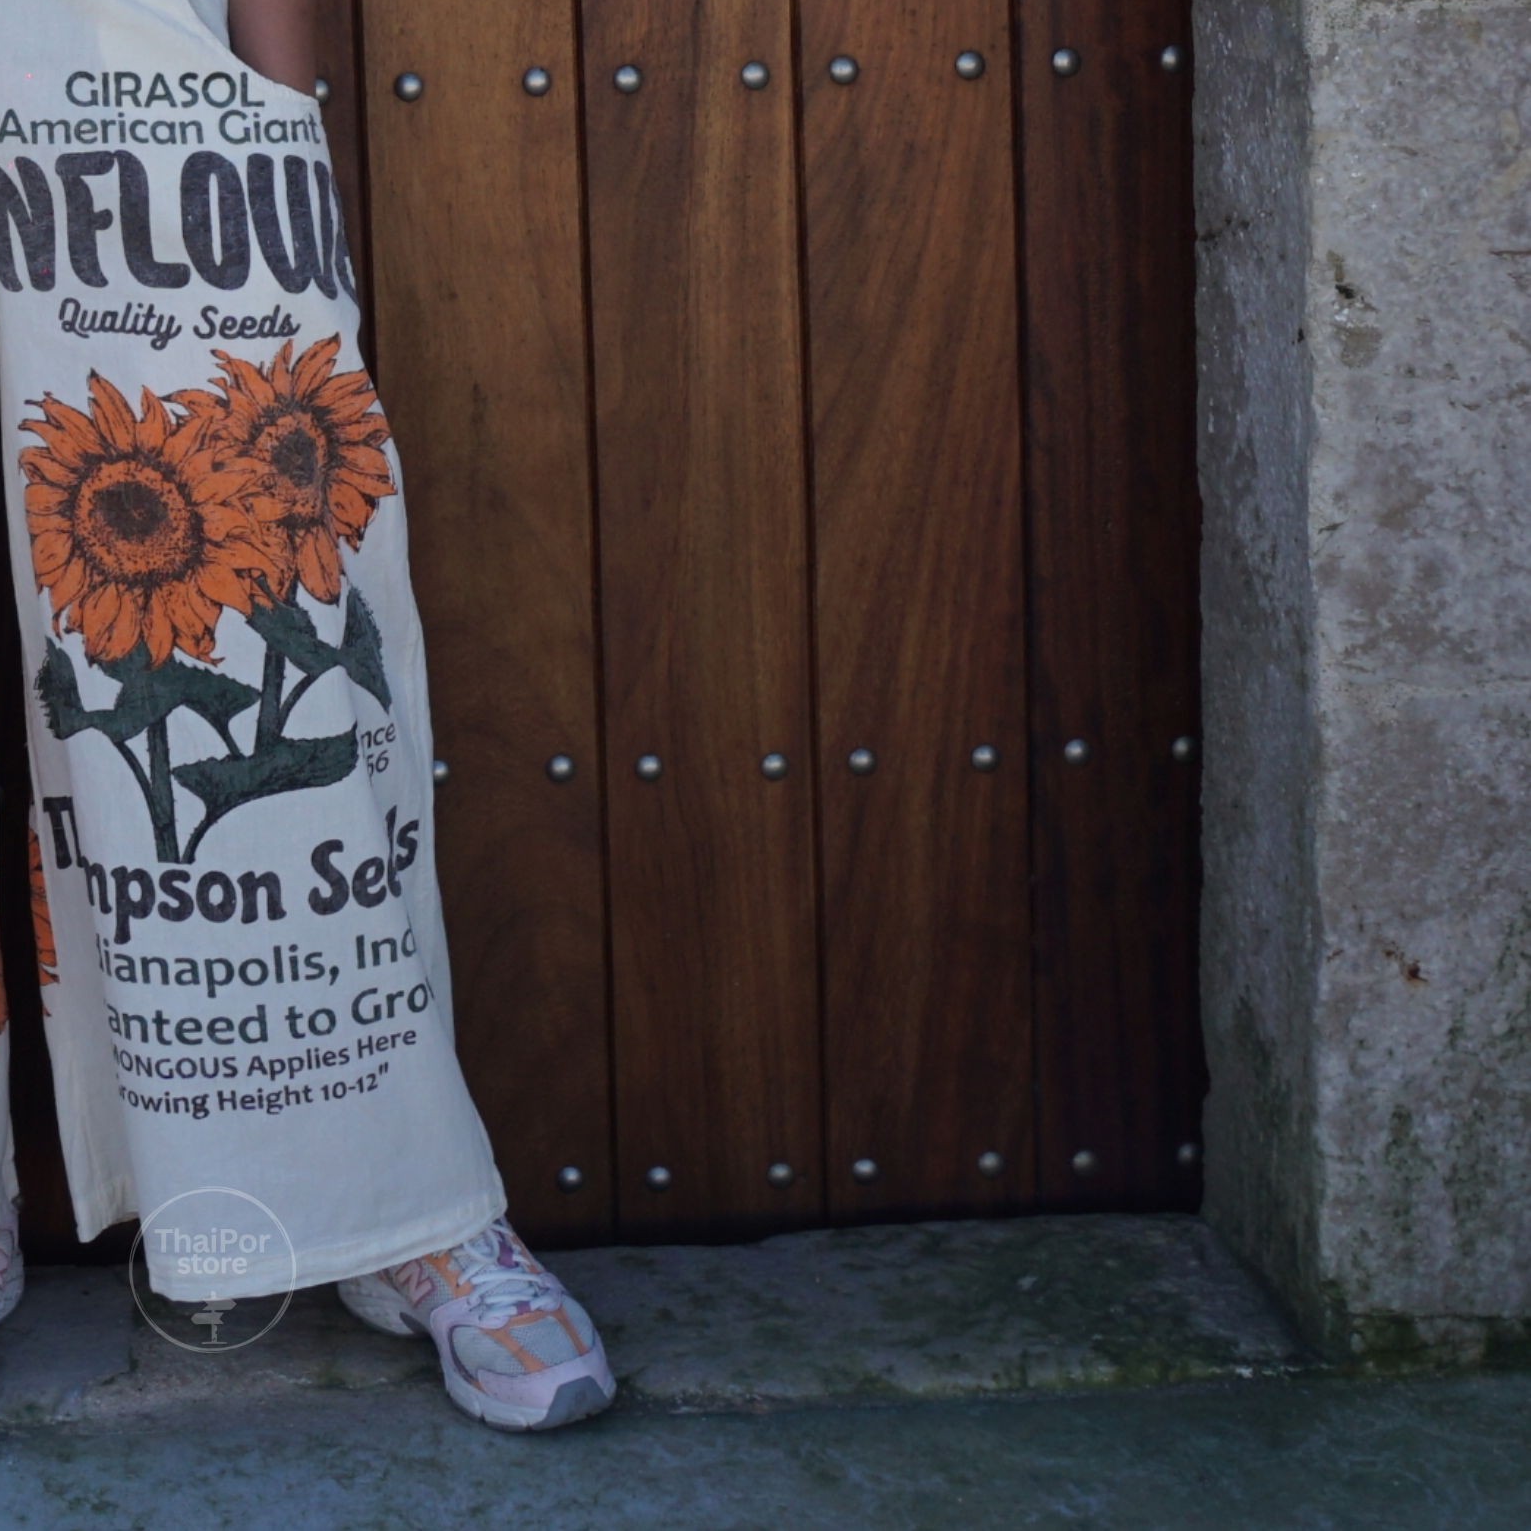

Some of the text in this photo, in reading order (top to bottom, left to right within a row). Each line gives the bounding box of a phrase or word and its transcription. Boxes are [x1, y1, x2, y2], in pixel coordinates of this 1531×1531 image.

[65, 71, 266, 109] GIRASOL
[218, 109, 321, 146] Giant
[58, 297, 301, 350] Quality Seeds
[285, 1005, 337, 1040] to
[246, 1047, 350, 1082] Applies
[357, 1030, 417, 1059] Here
[218, 1084, 313, 1115] Height
[321, 1061, 389, 1102] 10-12"
